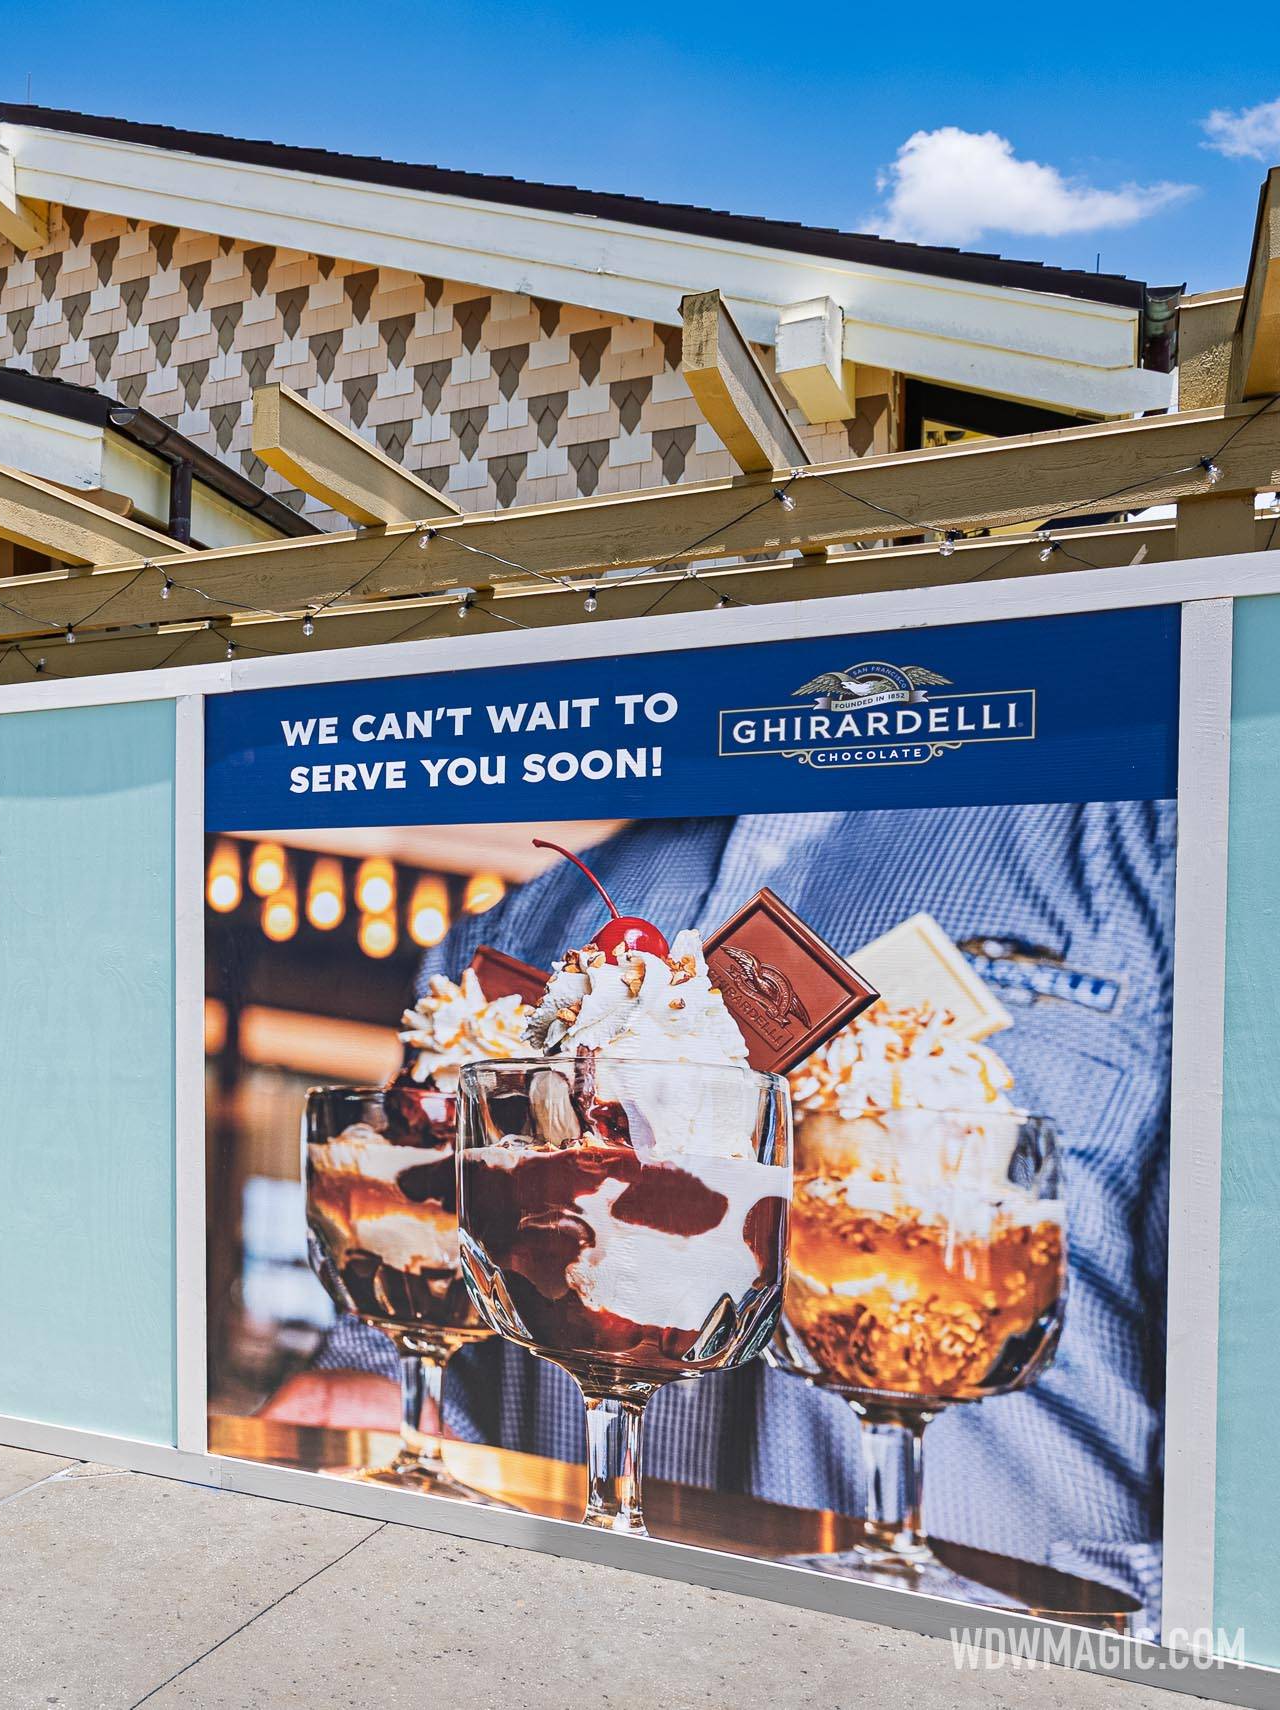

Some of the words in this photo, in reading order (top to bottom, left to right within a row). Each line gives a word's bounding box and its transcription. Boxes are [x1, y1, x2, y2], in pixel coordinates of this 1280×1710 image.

[853, 667, 868, 676] SAN
[871, 666, 907, 690] FRANCISCO
[834, 697, 874, 710] FOUNDED
[876, 695, 885, 703] IN
[888, 692, 905, 700] 1852
[280, 716, 339, 747] WE
[351, 706, 472, 743] CAN'T
[485, 697, 600, 734] WAIT
[615, 691, 679, 725] TO
[732, 702, 1018, 744] GHIRARDELLI
[289, 760, 407, 794] SERVE
[420, 754, 506, 788] YOU
[522, 746, 664, 783] SOON!
[817, 748, 923, 763] CHOCOLATE
